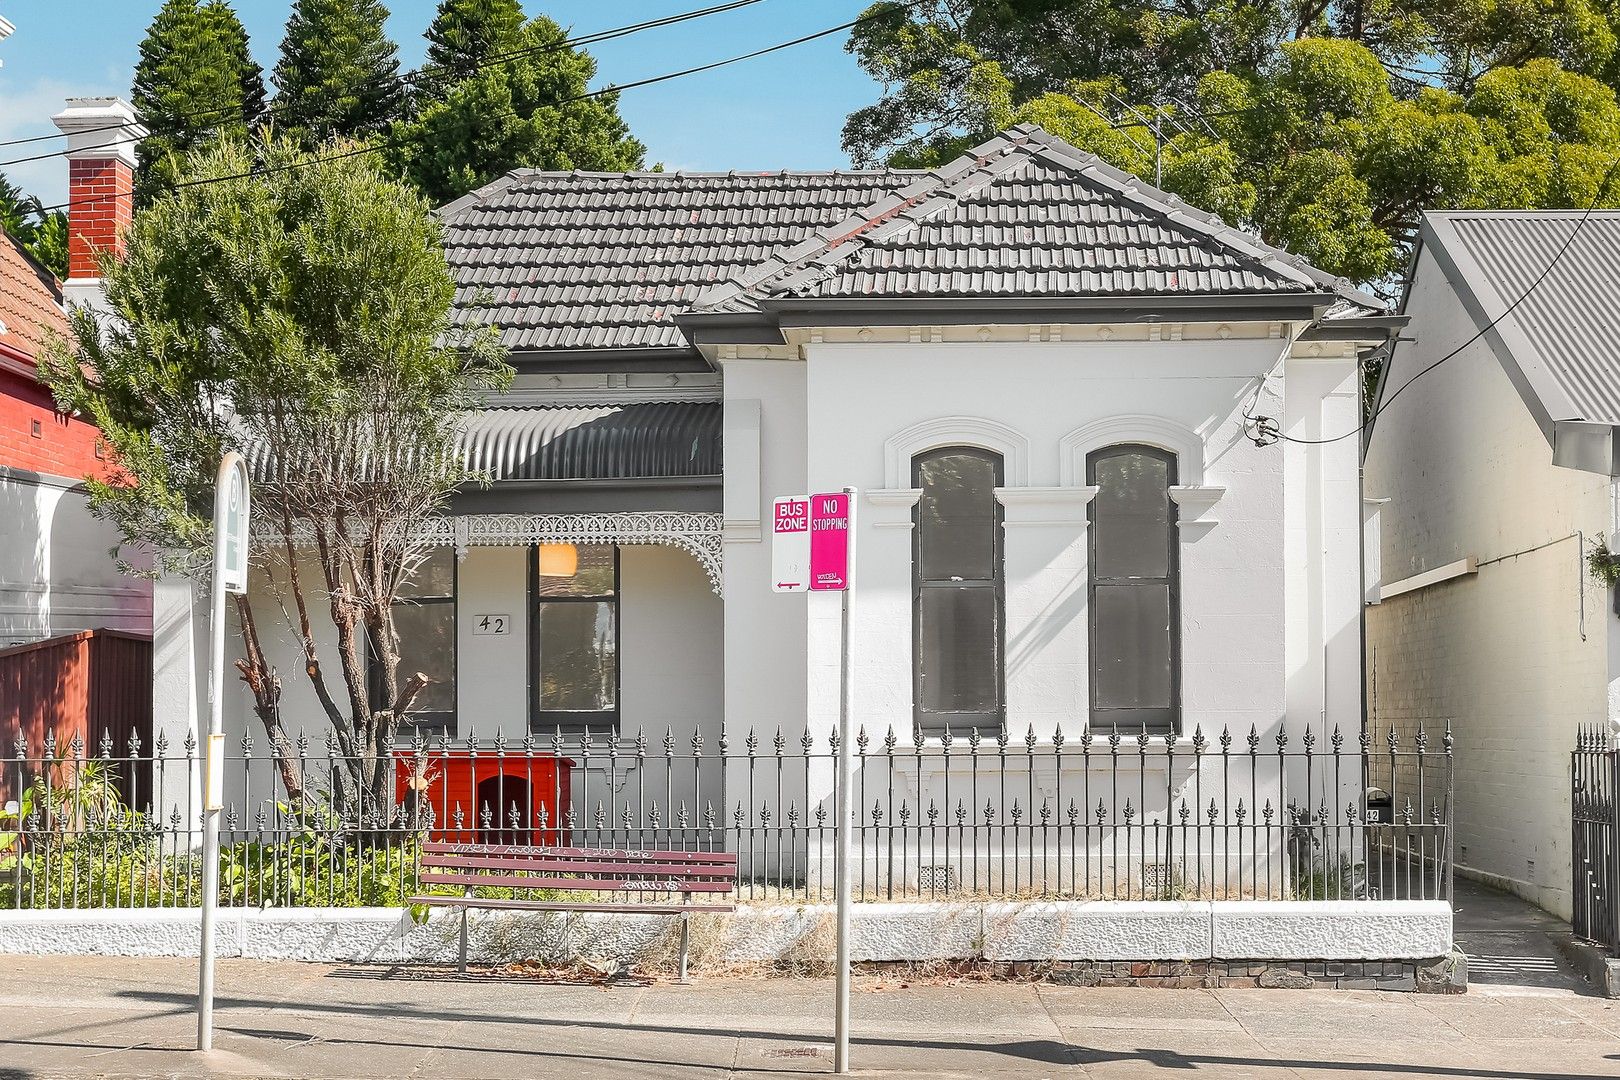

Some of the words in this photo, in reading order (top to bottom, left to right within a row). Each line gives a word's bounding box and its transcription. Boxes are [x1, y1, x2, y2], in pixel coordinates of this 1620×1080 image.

[780, 503, 803, 517] BUS
[823, 499, 838, 514] NO
[776, 517, 807, 531] ZONE
[812, 517, 848, 531] STOPPING
[479, 615, 504, 633] 42
[1366, 810, 1378, 821] 42
